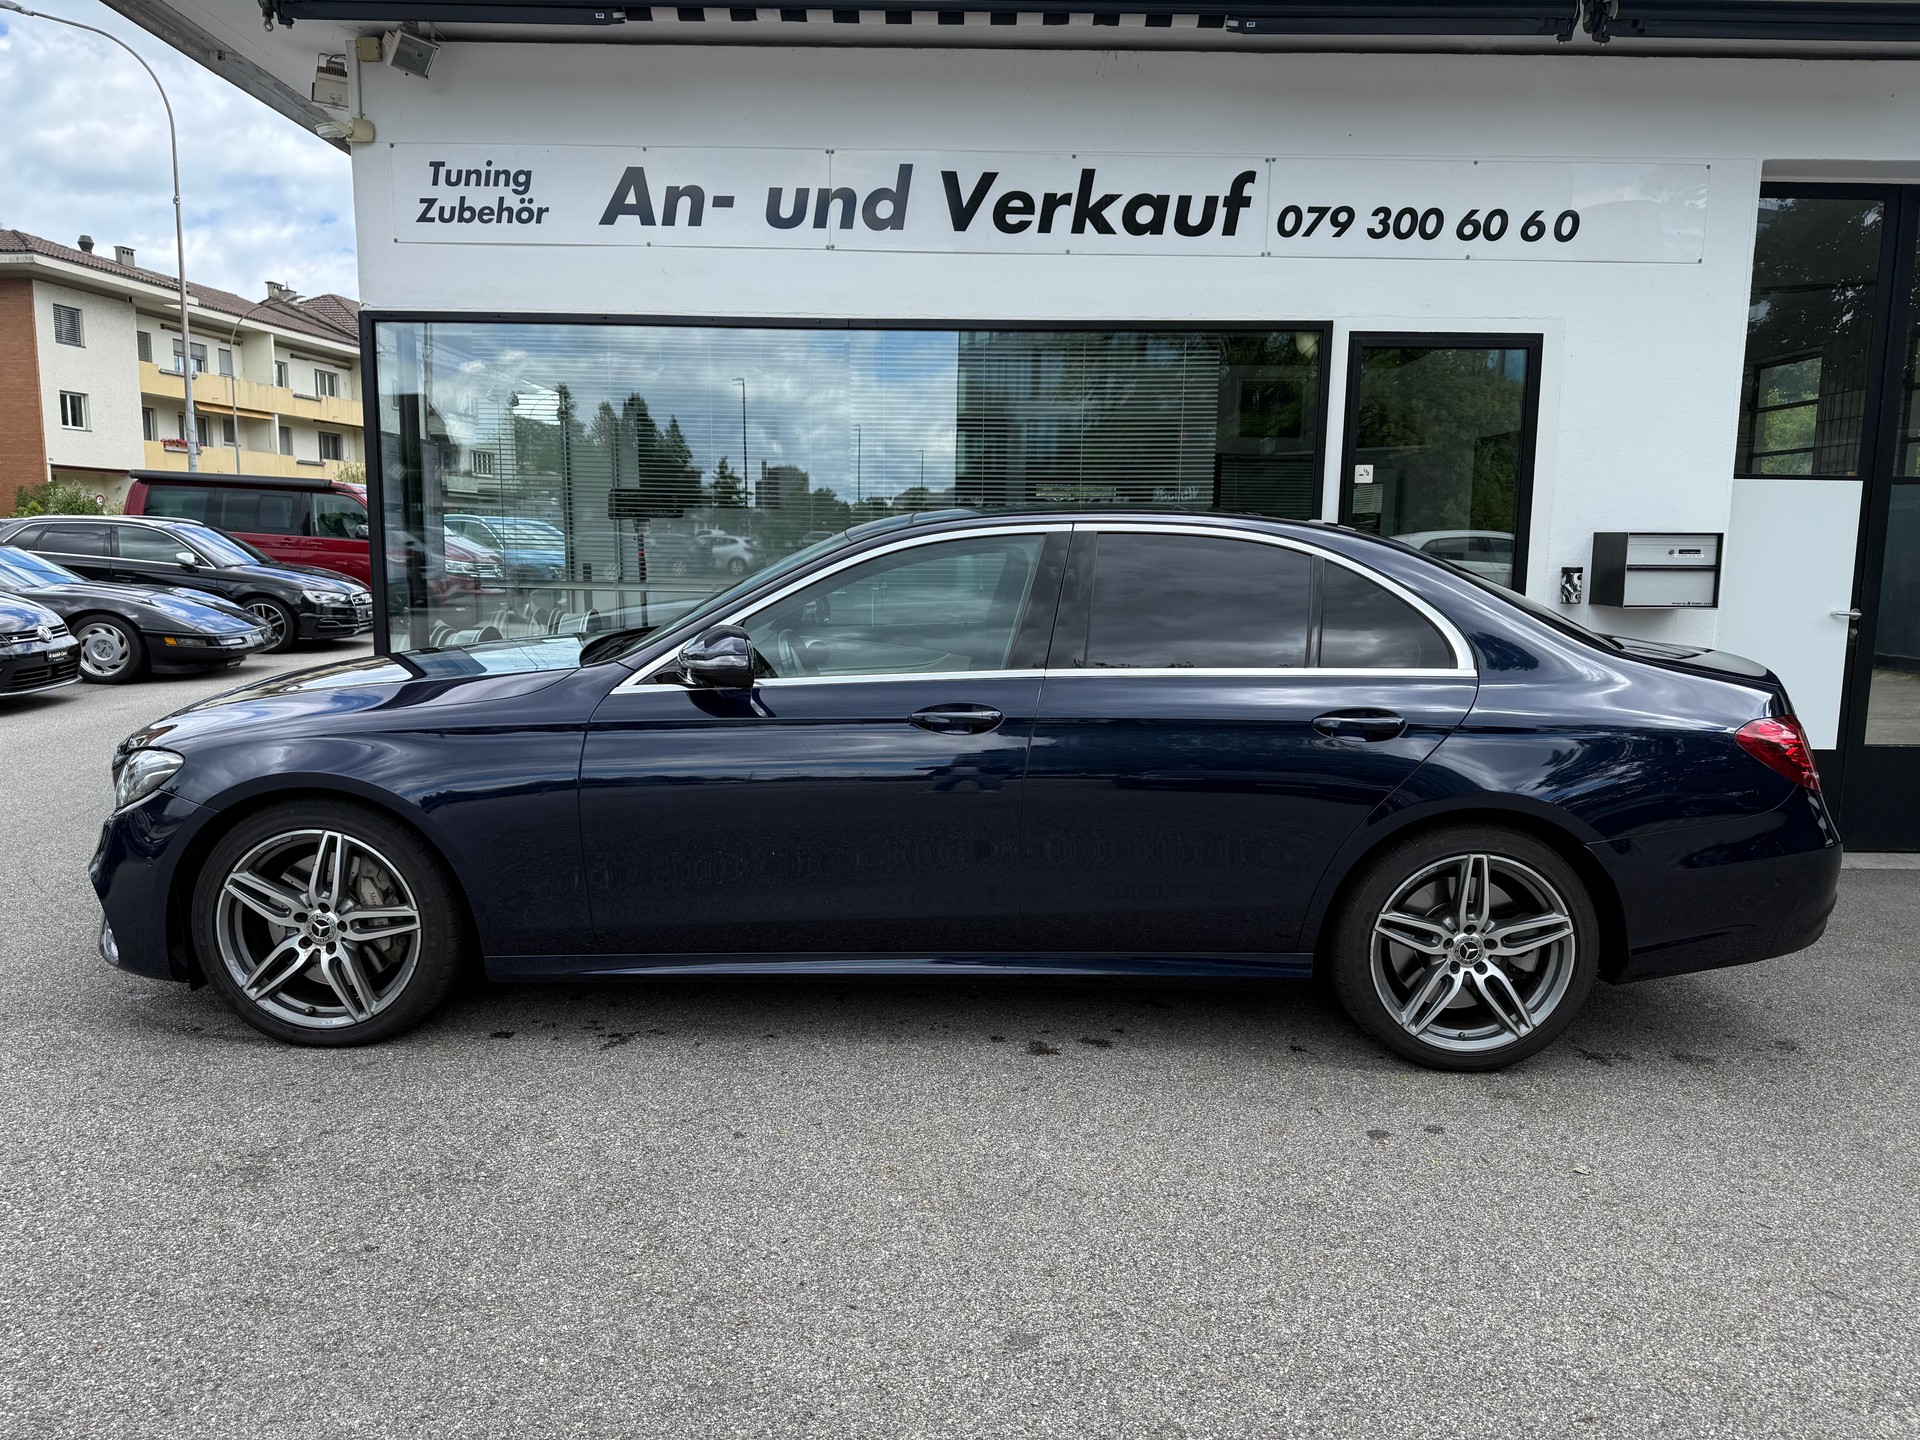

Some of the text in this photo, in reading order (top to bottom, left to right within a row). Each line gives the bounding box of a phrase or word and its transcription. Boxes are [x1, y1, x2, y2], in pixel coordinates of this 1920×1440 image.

[428, 159, 533, 196] Tuning
[415, 195, 550, 225] Zubehör
[598, 163, 1257, 238] An- und Verkauf
[1276, 204, 1356, 239] 079
[1366, 206, 1445, 241] 300
[1455, 208, 1509, 242] 60
